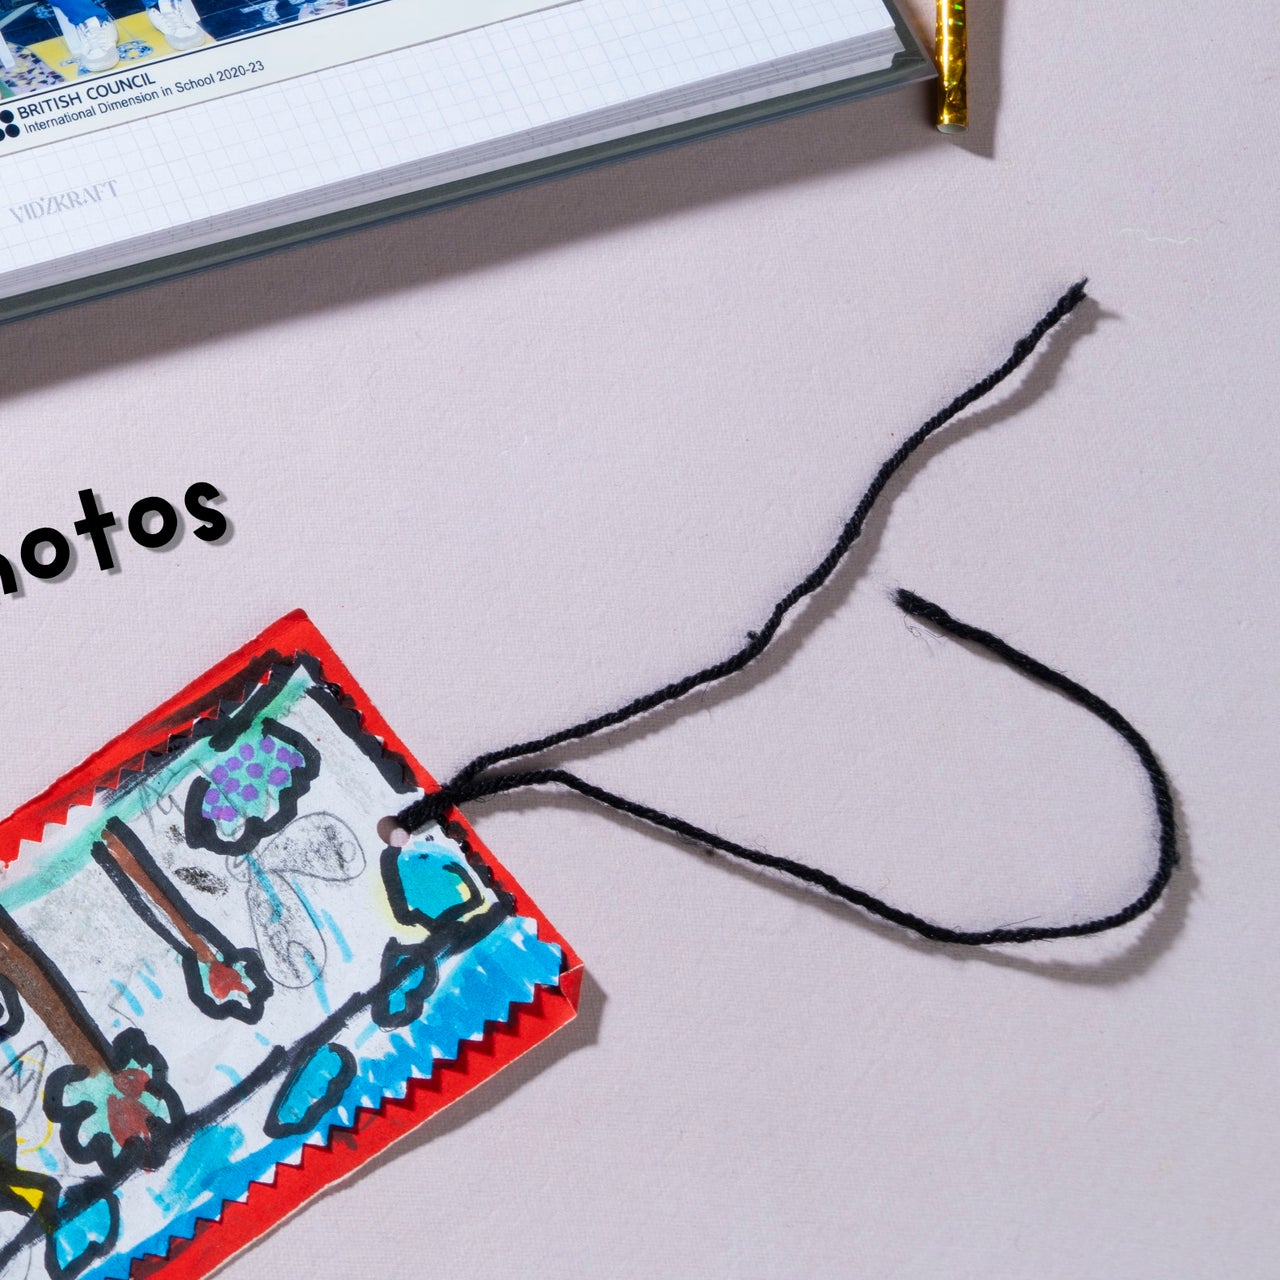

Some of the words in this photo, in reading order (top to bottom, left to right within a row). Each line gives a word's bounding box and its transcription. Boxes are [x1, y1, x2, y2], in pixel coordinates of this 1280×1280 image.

[17, 92, 82, 119] BRITISH
[86, 73, 156, 103] COUNCIL
[24, 106, 96, 133] International
[98, 91, 159, 113] Dimension
[160, 87, 173, 96] in
[175, 74, 215, 93] School
[217, 60, 264, 81] 2020-23
